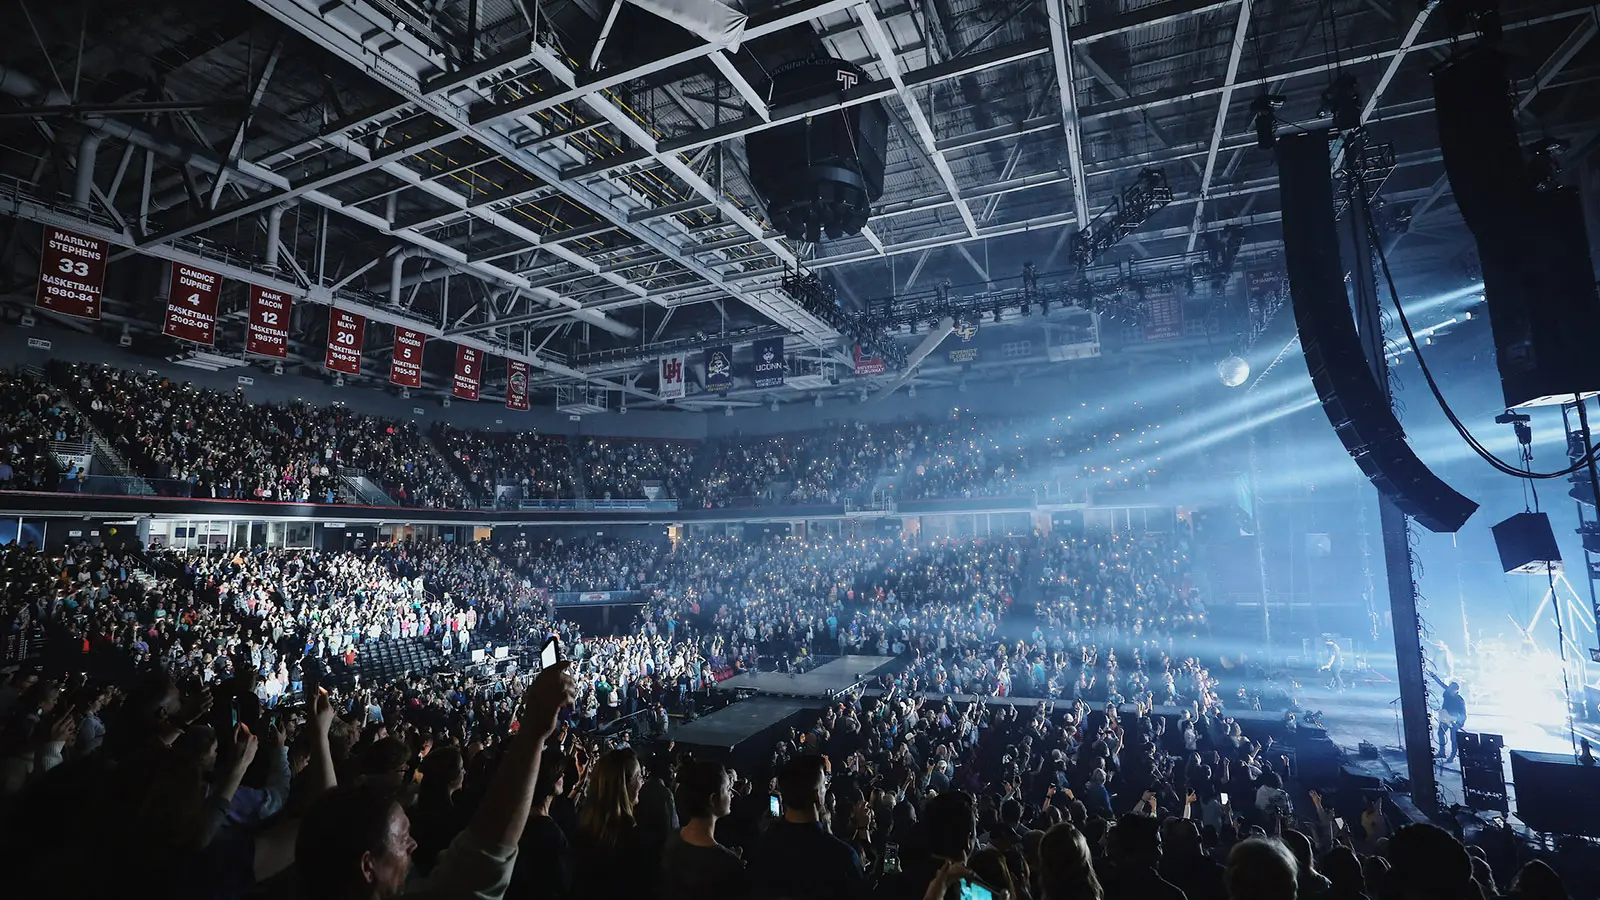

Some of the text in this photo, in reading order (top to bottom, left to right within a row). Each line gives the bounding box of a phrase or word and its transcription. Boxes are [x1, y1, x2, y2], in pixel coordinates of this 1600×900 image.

[54, 231, 98, 250] MARILYN
[49, 240, 101, 260] STEPHENS
[58, 258, 89, 277] 33
[180, 267, 215, 284] CANDICE
[42, 273, 101, 294] BASKETBALL
[180, 276, 212, 292] DUPREE
[47, 286, 93, 302] 1980-84
[187, 293, 200, 306] 4
[261, 291, 281, 301] MARK
[258, 298, 283, 309] MACON
[168, 304, 214, 322] BASKETBALL
[261, 311, 278, 325] 12
[341, 314, 354, 323] BILL
[170, 314, 209, 329] 2002-06
[337, 320, 357, 330] MLKVY
[250, 323, 288, 337] BASKETBALL
[405, 331, 416, 339] GUY
[254, 333, 282, 344] 1987-91
[336, 331, 354, 345] 20
[398, 336, 421, 347] RODGERS
[329, 342, 361, 356] BASKETBALL
[403, 348, 412, 359] 5
[331, 352, 356, 362] 1949-52
[463, 354, 475, 363] LEAR
[393, 359, 421, 369] BASKETBALL
[464, 364, 472, 374] 6
[662, 357, 682, 384] UH
[755, 361, 782, 372] UCONN
[454, 373, 478, 384] BASKETBALL
